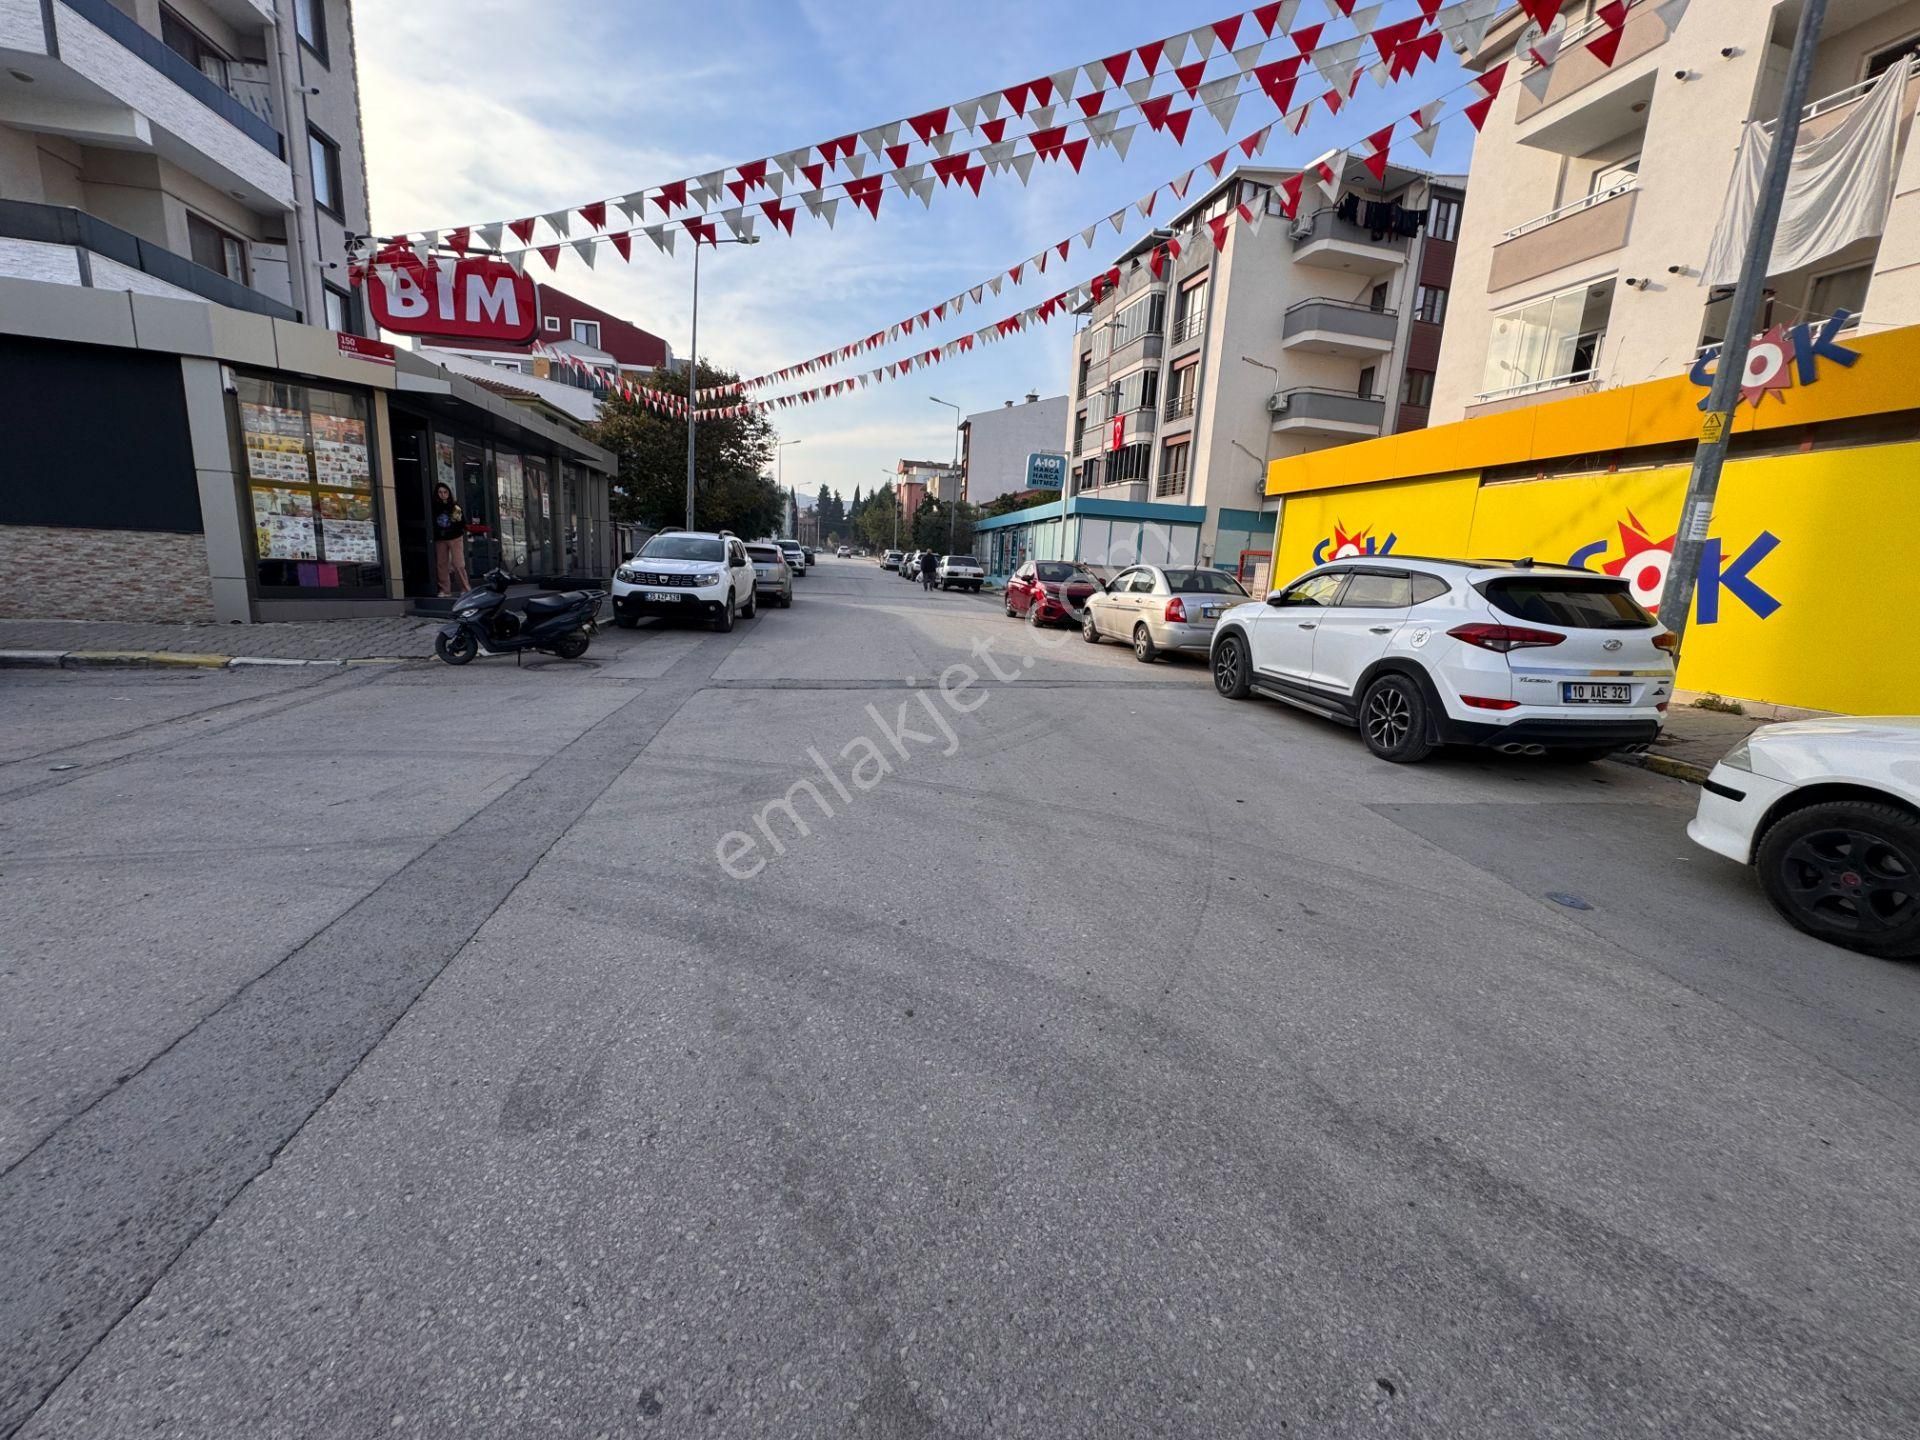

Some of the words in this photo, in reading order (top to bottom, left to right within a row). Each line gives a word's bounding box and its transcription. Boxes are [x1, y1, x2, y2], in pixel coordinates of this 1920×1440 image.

[340, 335, 356, 346] 150
[1033, 466, 1059, 474] HARCA
[1033, 473, 1059, 481] HARCA
[1573, 686, 1584, 698] 10
[1590, 686, 1607, 698] AAE
[1612, 686, 1628, 699] 321
